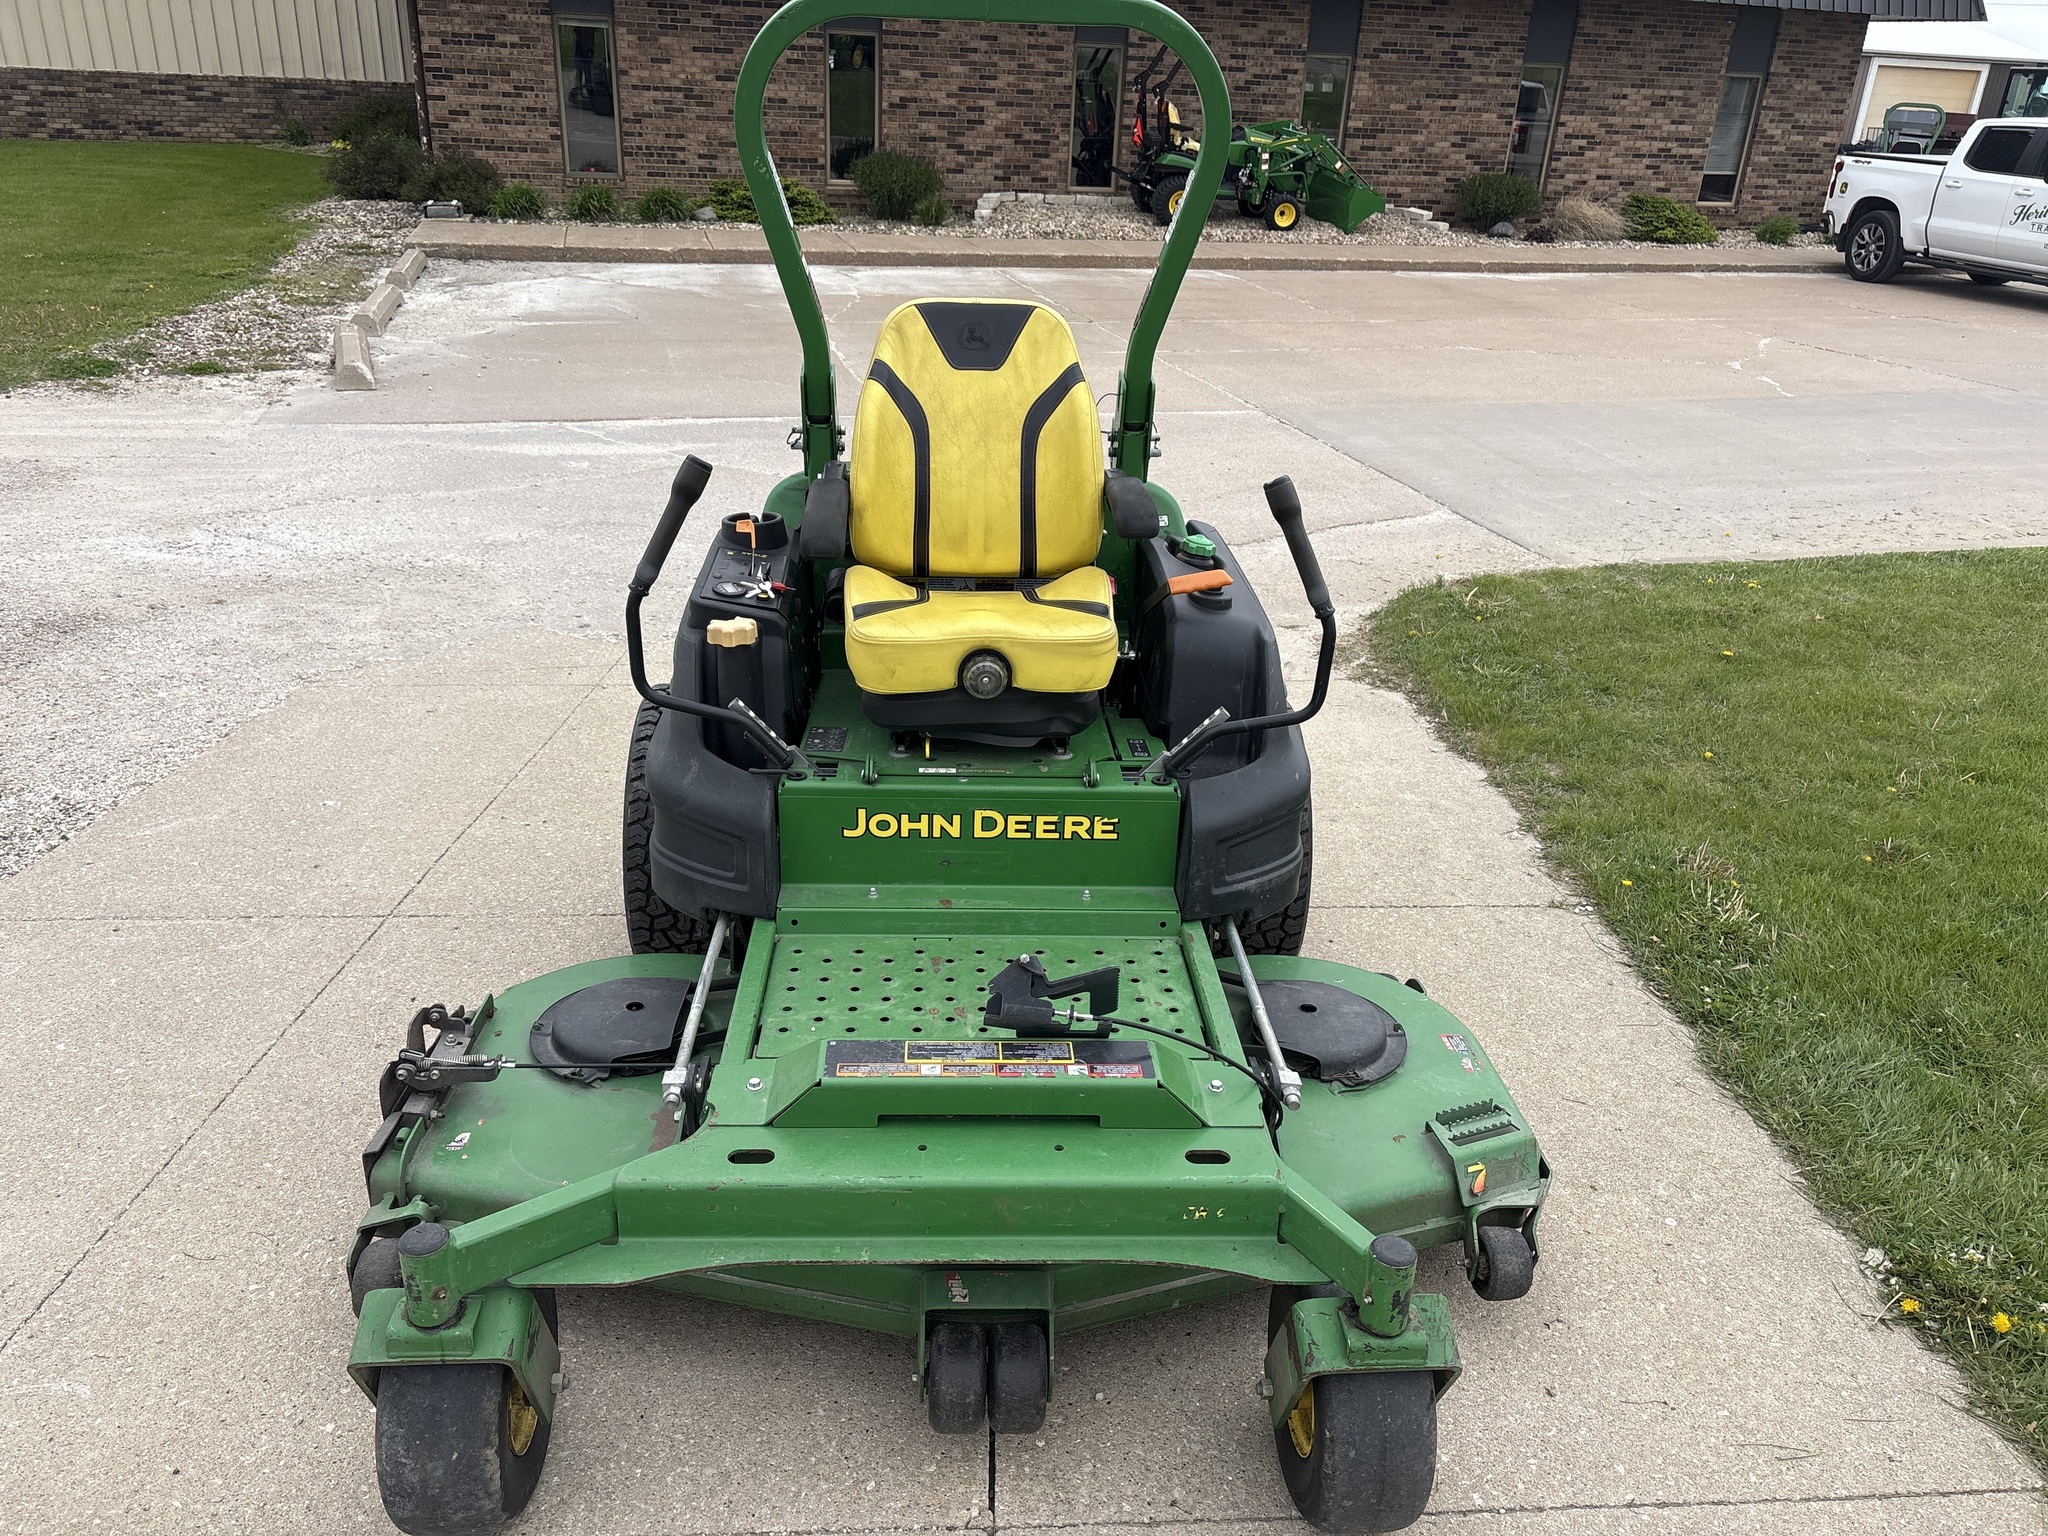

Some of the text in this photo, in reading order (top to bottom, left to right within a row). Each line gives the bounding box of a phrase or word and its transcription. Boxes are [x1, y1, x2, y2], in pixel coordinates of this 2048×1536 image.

[842, 807, 1119, 840] JOHN DEERE
[1466, 1162, 1487, 1196] 7
